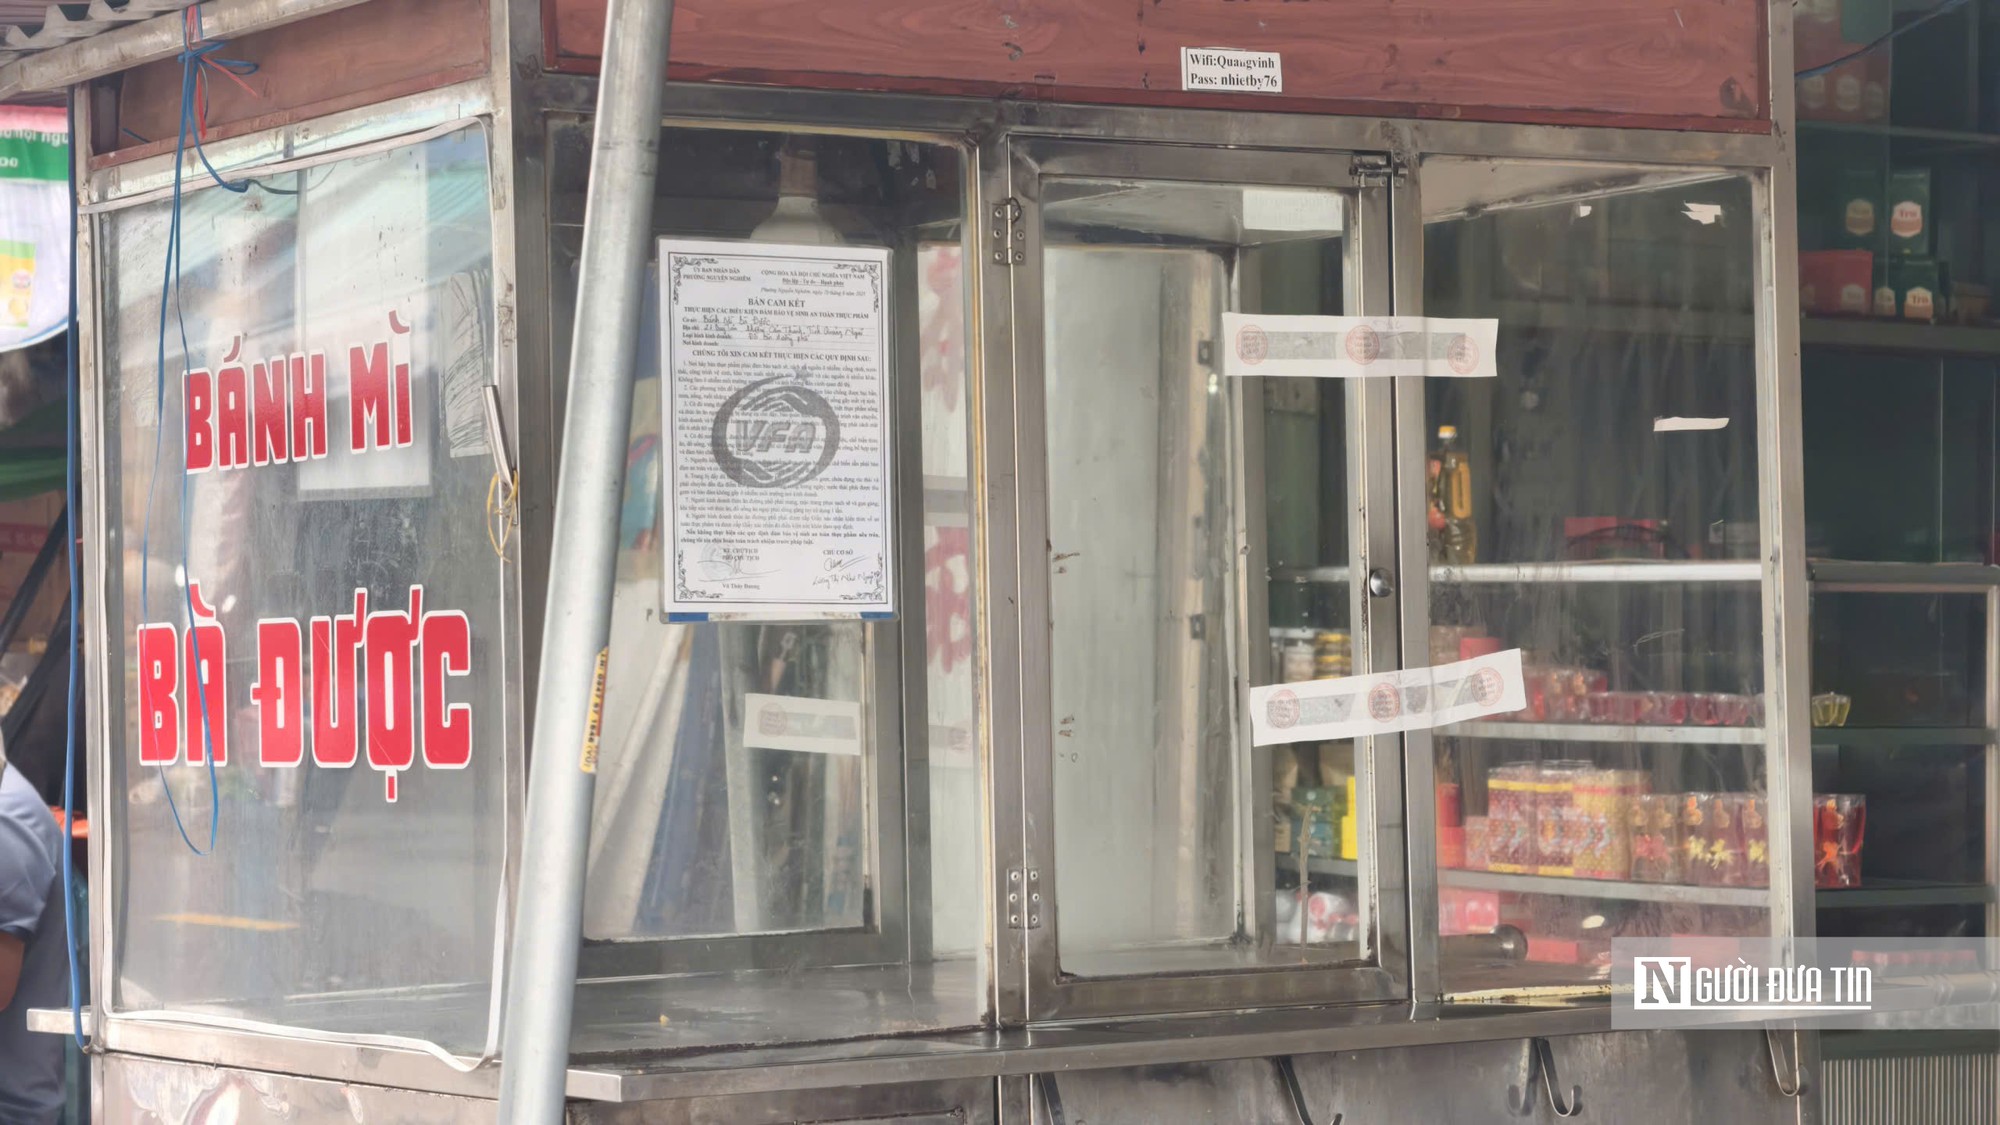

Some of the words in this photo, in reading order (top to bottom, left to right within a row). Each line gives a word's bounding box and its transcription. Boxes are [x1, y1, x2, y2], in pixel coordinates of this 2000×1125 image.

[1190, 73, 1217, 85] Pass:
[748, 296, 765, 306] BẢN
[767, 299, 786, 307] CAM
[788, 298, 805, 308] KẾT
[692, 349, 716, 357] CHÚNG
[717, 349, 728, 357] TÔI
[729, 350, 741, 358] XIN
[759, 350, 772, 358] KẾT
[774, 352, 792, 360] THỰC
[840, 354, 856, 362] ĐỊNH
[182, 331, 328, 475] BÁNH
[349, 309, 413, 454] MÌ
[137, 581, 227, 767] BÀ
[250, 584, 472, 802] ĐƯỢC
